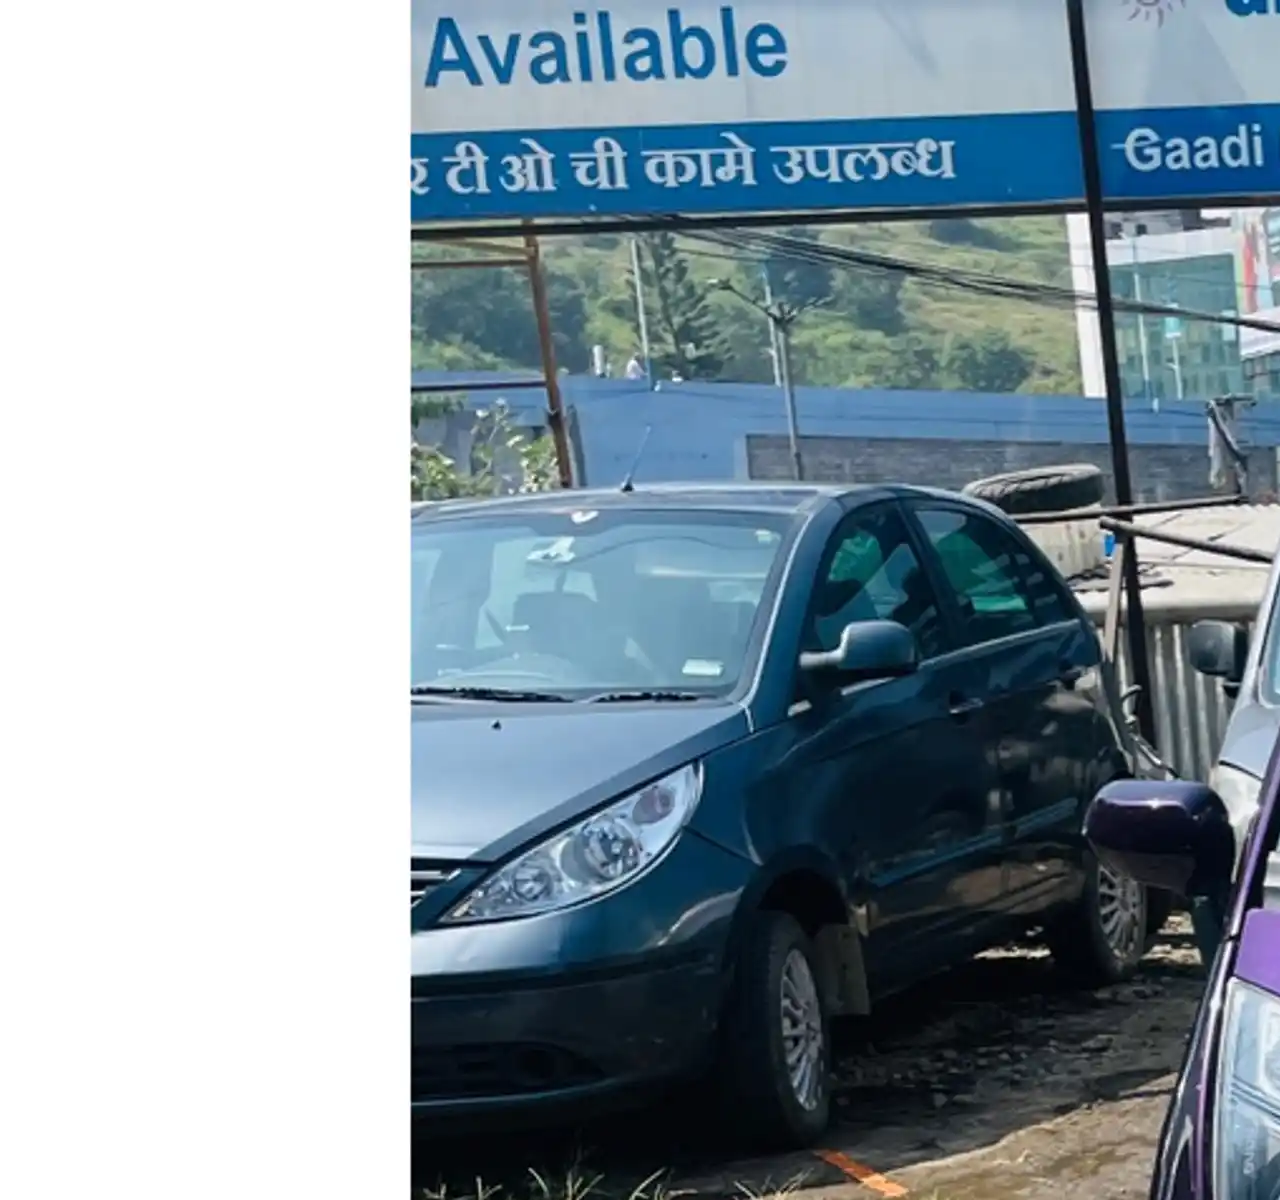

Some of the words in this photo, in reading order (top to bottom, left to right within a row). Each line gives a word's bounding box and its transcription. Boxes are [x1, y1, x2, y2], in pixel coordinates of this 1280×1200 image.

[424, 6, 788, 87] Available
[569, 137, 628, 190] ची
[641, 132, 758, 187] कामे
[770, 138, 956, 183] उपलब्ध
[1124, 124, 1263, 173] Gaadi
